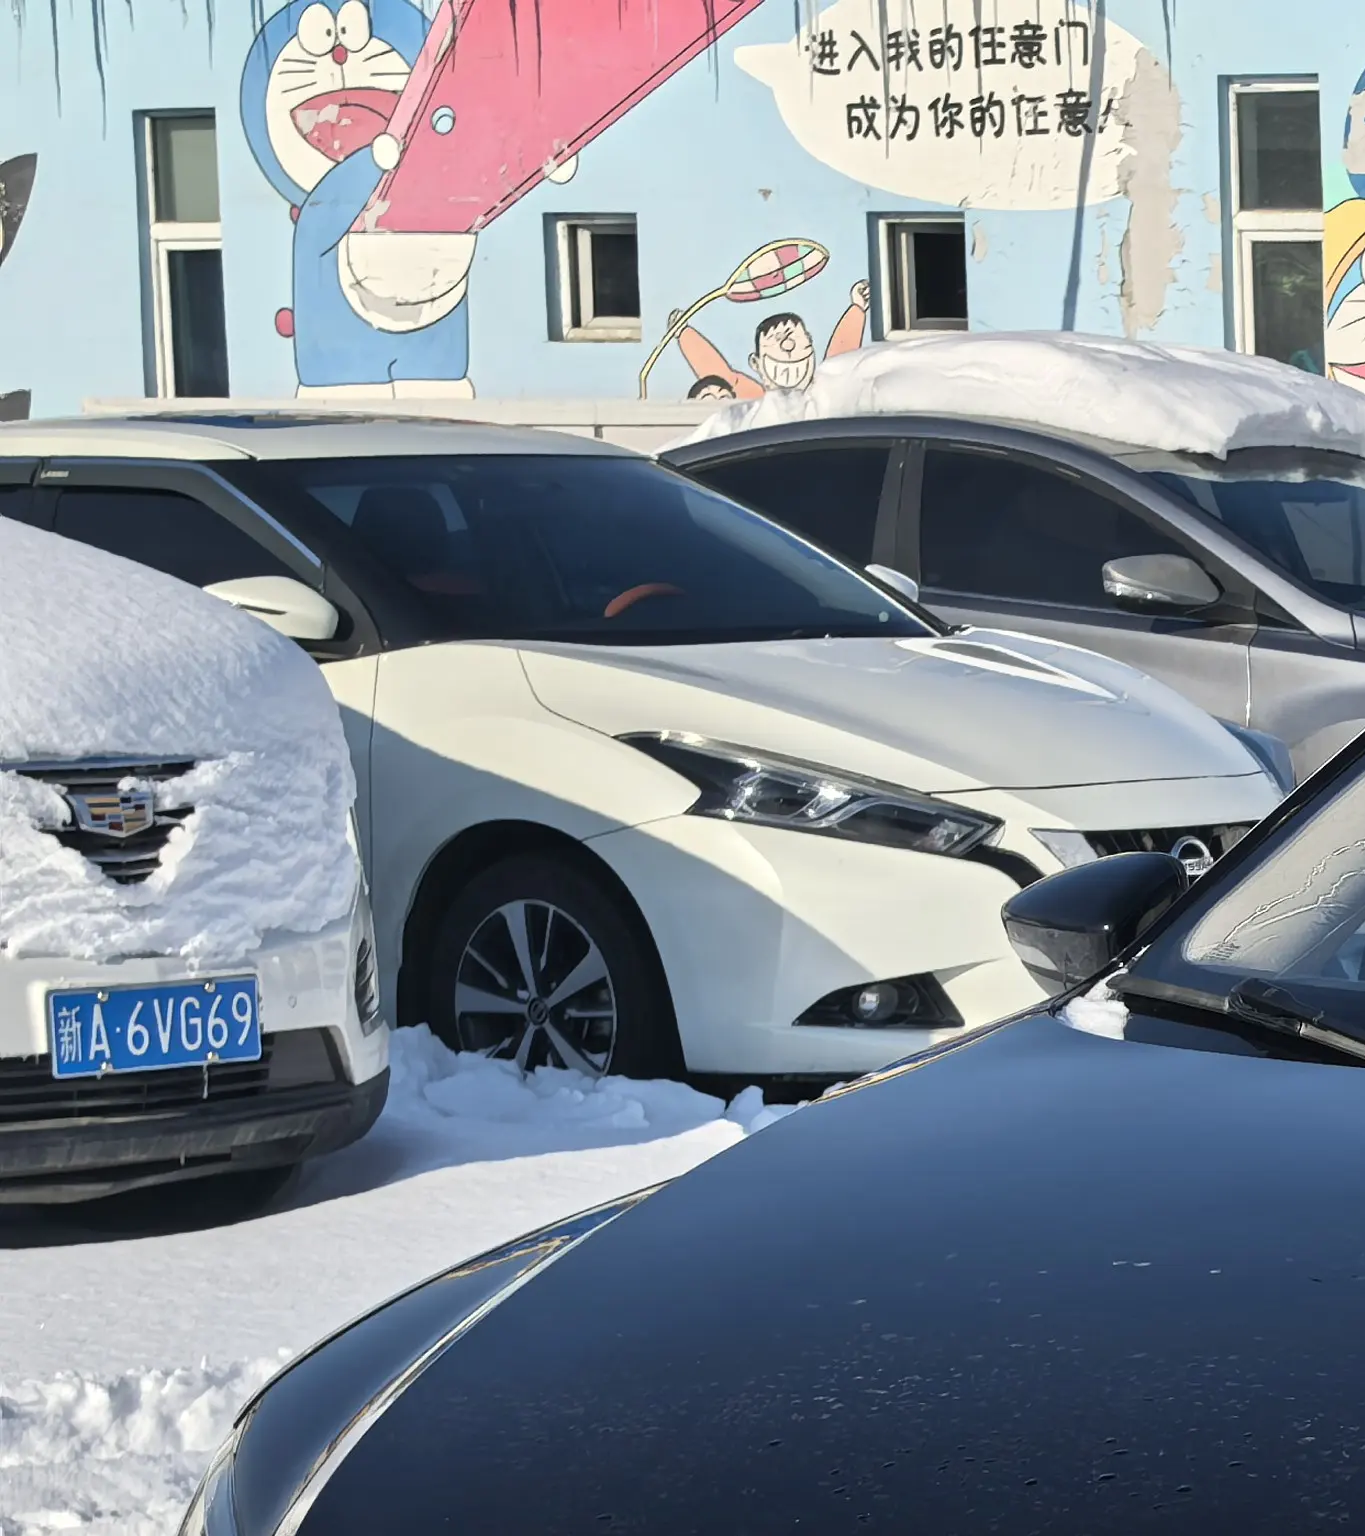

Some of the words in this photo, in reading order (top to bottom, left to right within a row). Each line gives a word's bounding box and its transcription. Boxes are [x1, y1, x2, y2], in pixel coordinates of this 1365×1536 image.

[805, 19, 1089, 76] 进入我的任意门
[846, 87, 1114, 141] 成为你的任意
